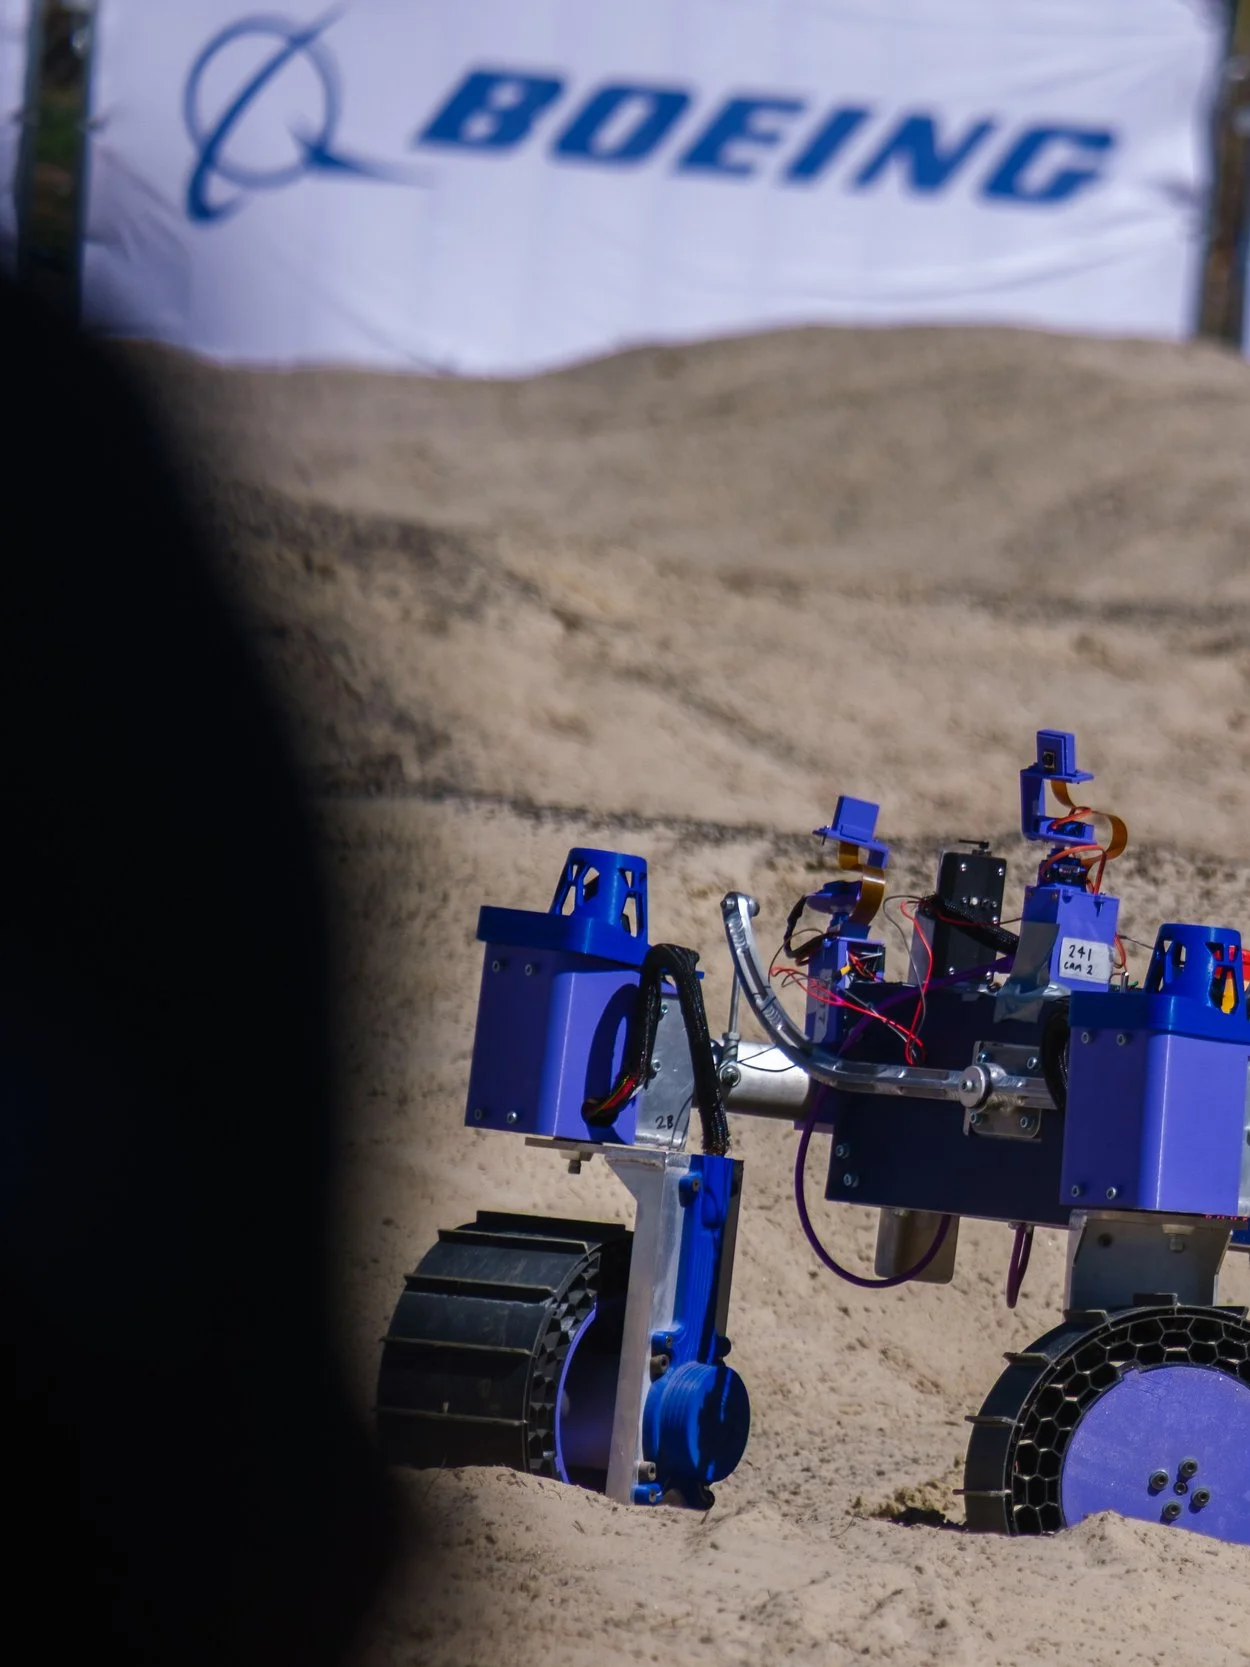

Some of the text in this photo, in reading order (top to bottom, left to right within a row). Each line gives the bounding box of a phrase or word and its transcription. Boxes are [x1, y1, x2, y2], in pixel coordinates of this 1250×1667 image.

[413, 67, 1116, 207] BOEING
[1068, 944, 1092, 961] 241
[1086, 964, 1093, 975] 2
